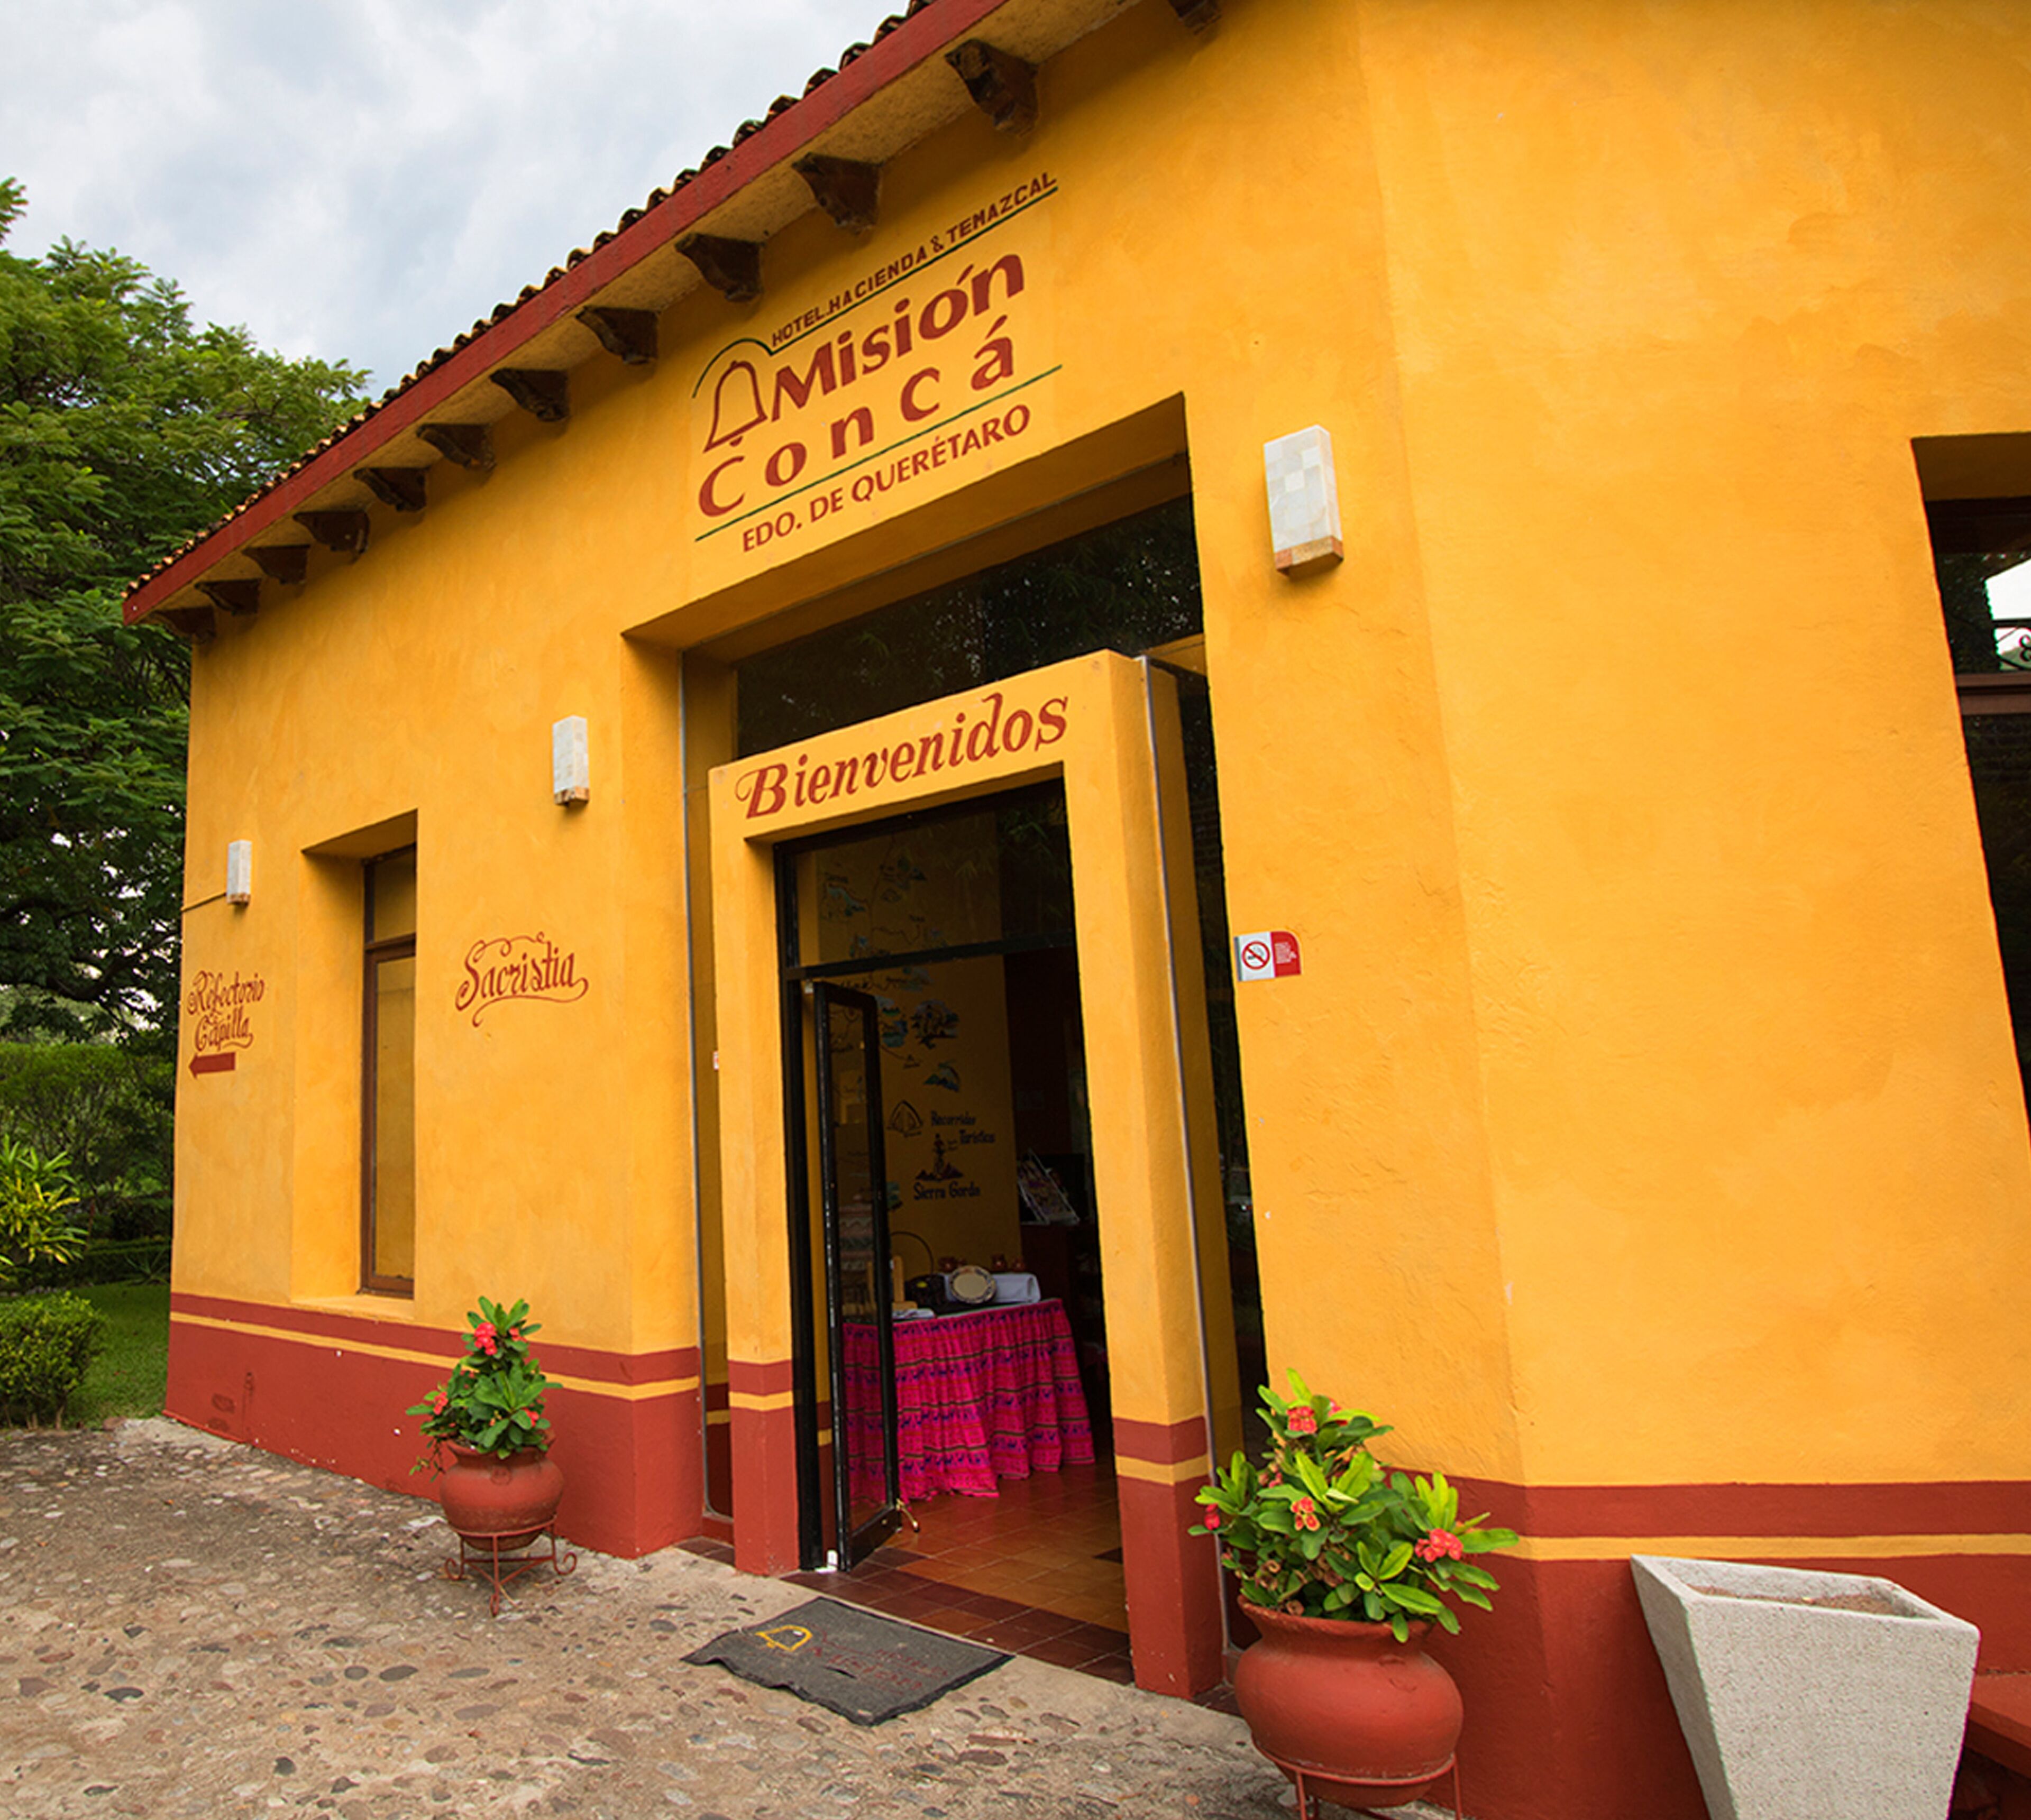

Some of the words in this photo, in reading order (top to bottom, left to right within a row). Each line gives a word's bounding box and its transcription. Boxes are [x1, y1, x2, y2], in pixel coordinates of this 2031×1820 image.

[931, 236, 945, 254] &
[946, 172, 1057, 243] TEMAZCAL
[772, 254, 1024, 422] Misión
[743, 511, 802, 552] EDO.
[810, 488, 844, 522] DE
[852, 405, 1030, 501] QUERÉTARO
[736, 693, 1068, 819] Bienvenidos
